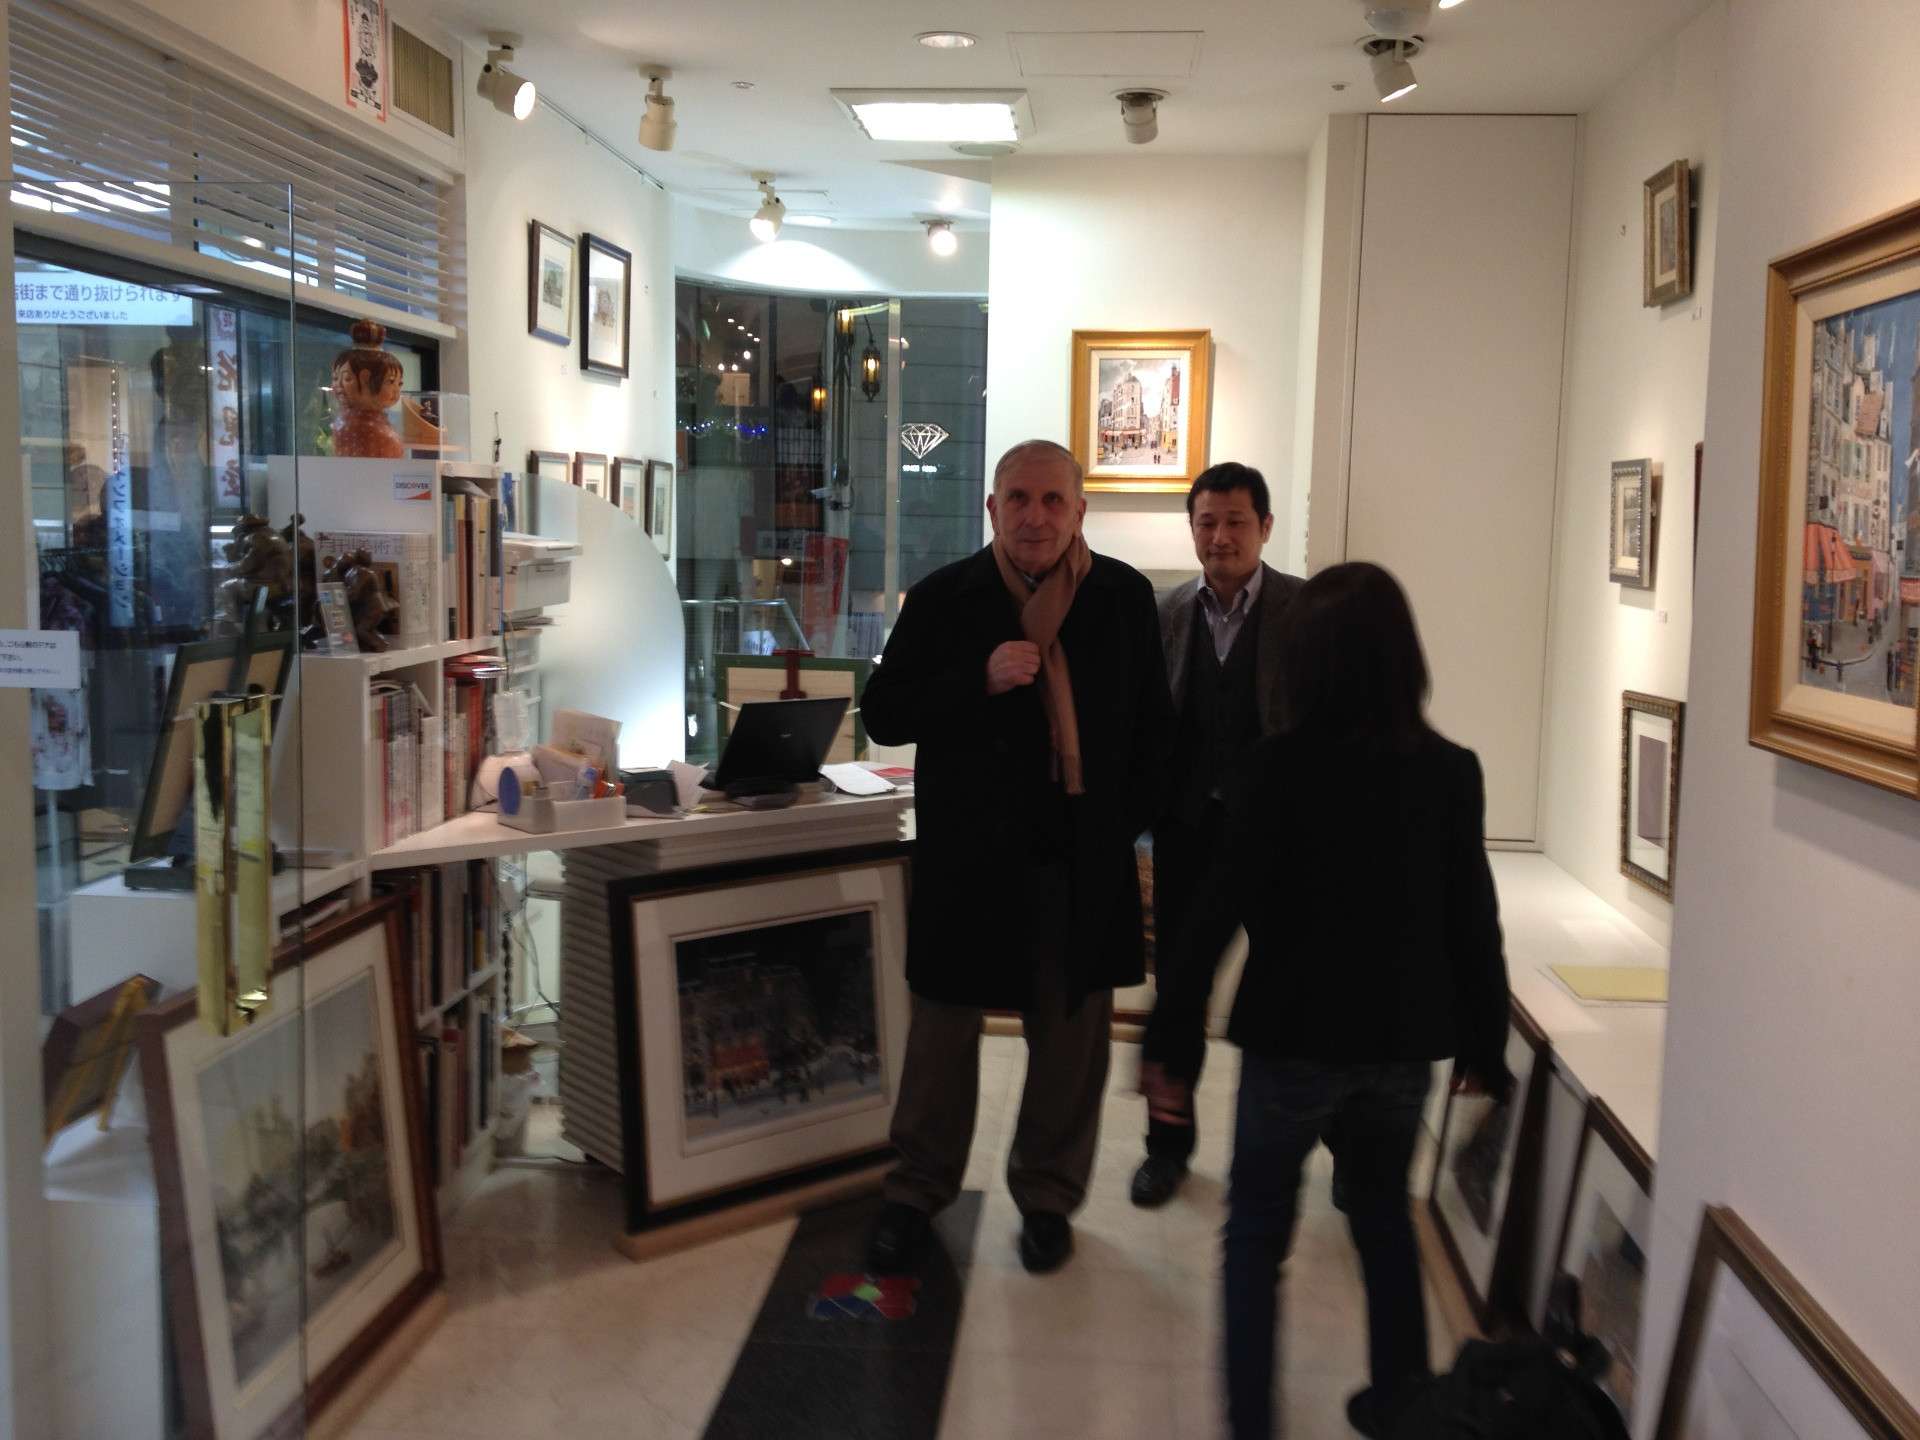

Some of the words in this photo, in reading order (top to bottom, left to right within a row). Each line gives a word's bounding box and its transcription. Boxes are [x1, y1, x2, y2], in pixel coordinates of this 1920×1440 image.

[15, 283, 181, 302] 街まで通り抜けられます
[395, 481, 429, 489] DISCOVER
